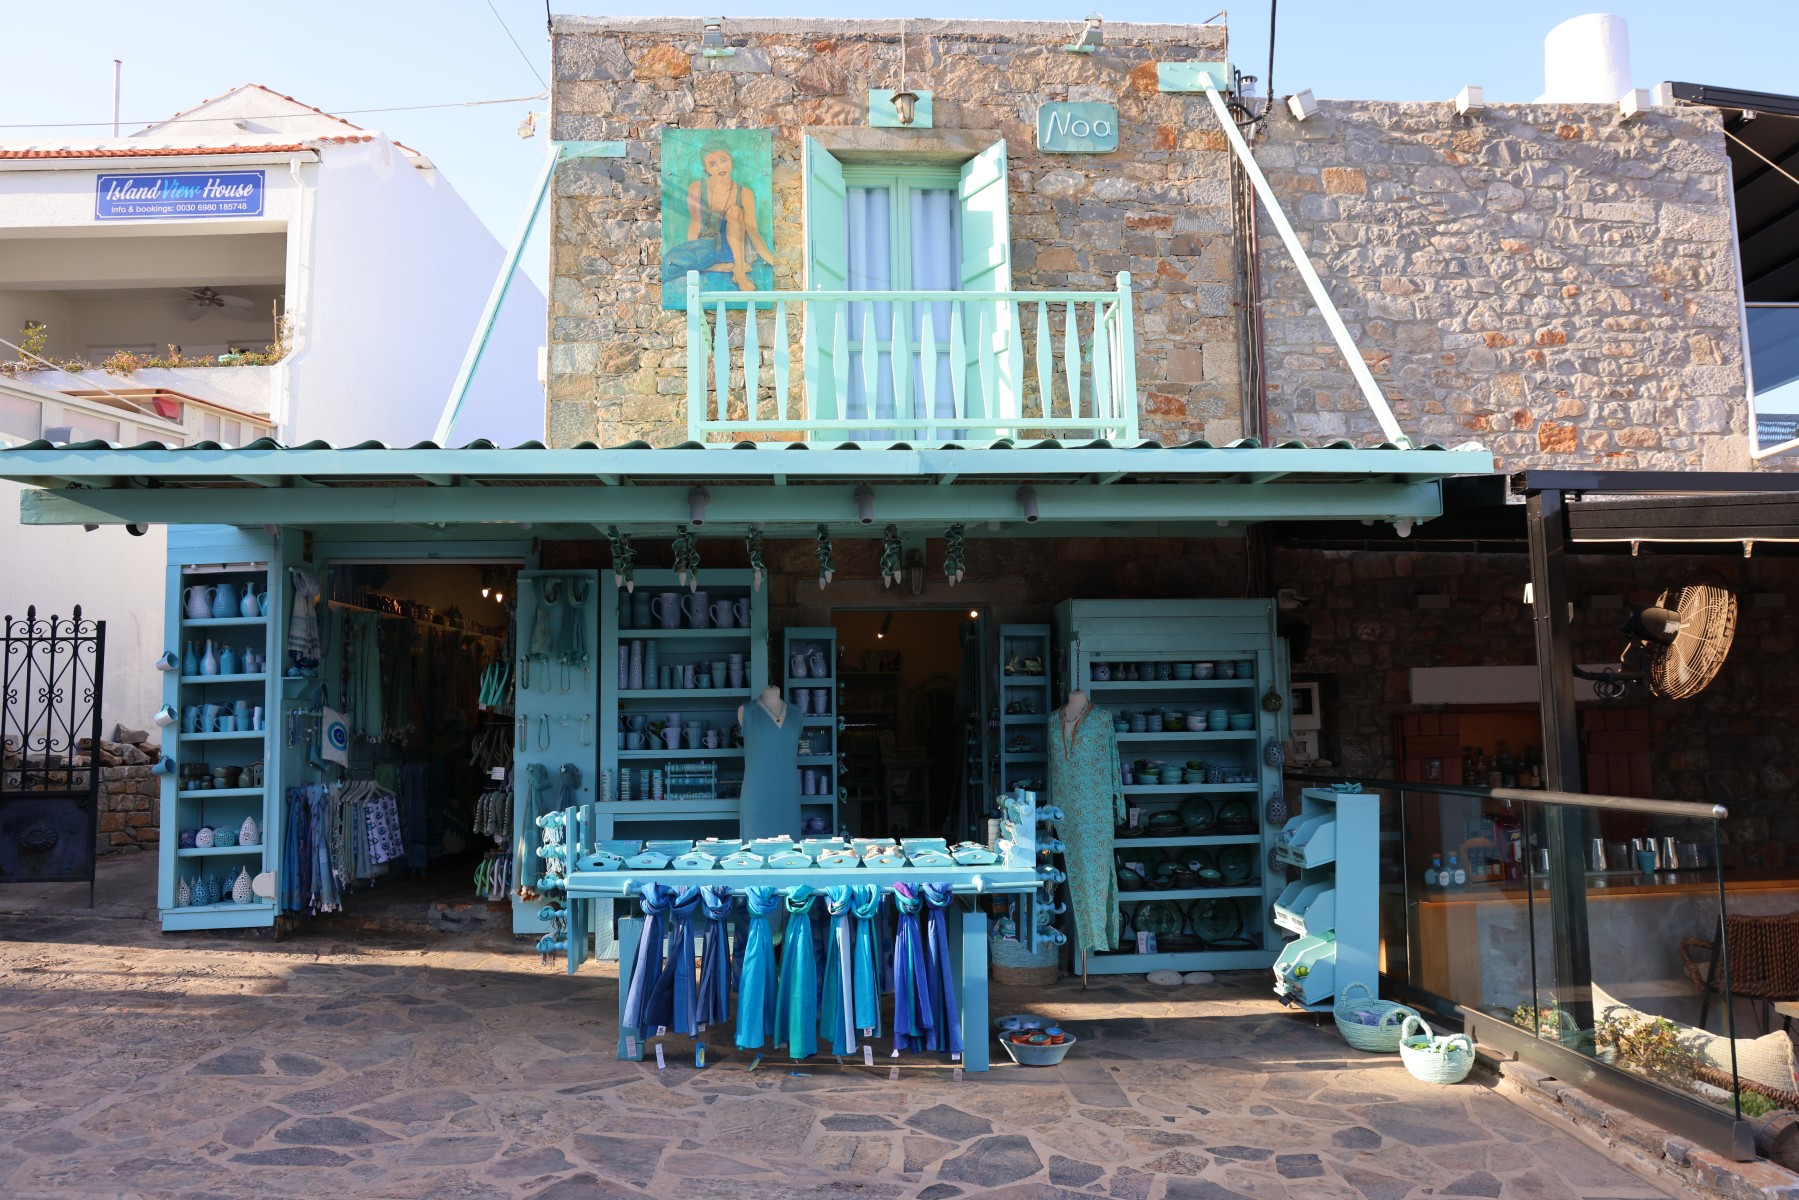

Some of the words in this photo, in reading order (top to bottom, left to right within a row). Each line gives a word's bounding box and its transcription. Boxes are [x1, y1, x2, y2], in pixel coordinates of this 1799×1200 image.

[1045, 111, 1112, 144] Noa
[106, 179, 162, 200] Island
[161, 178, 201, 200] View
[203, 178, 254, 198] House
[111, 205, 127, 213] info
[128, 205, 134, 213] &
[135, 204, 175, 214] bookings:
[176, 203, 196, 212] 0030
[197, 203, 217, 211] 6980
